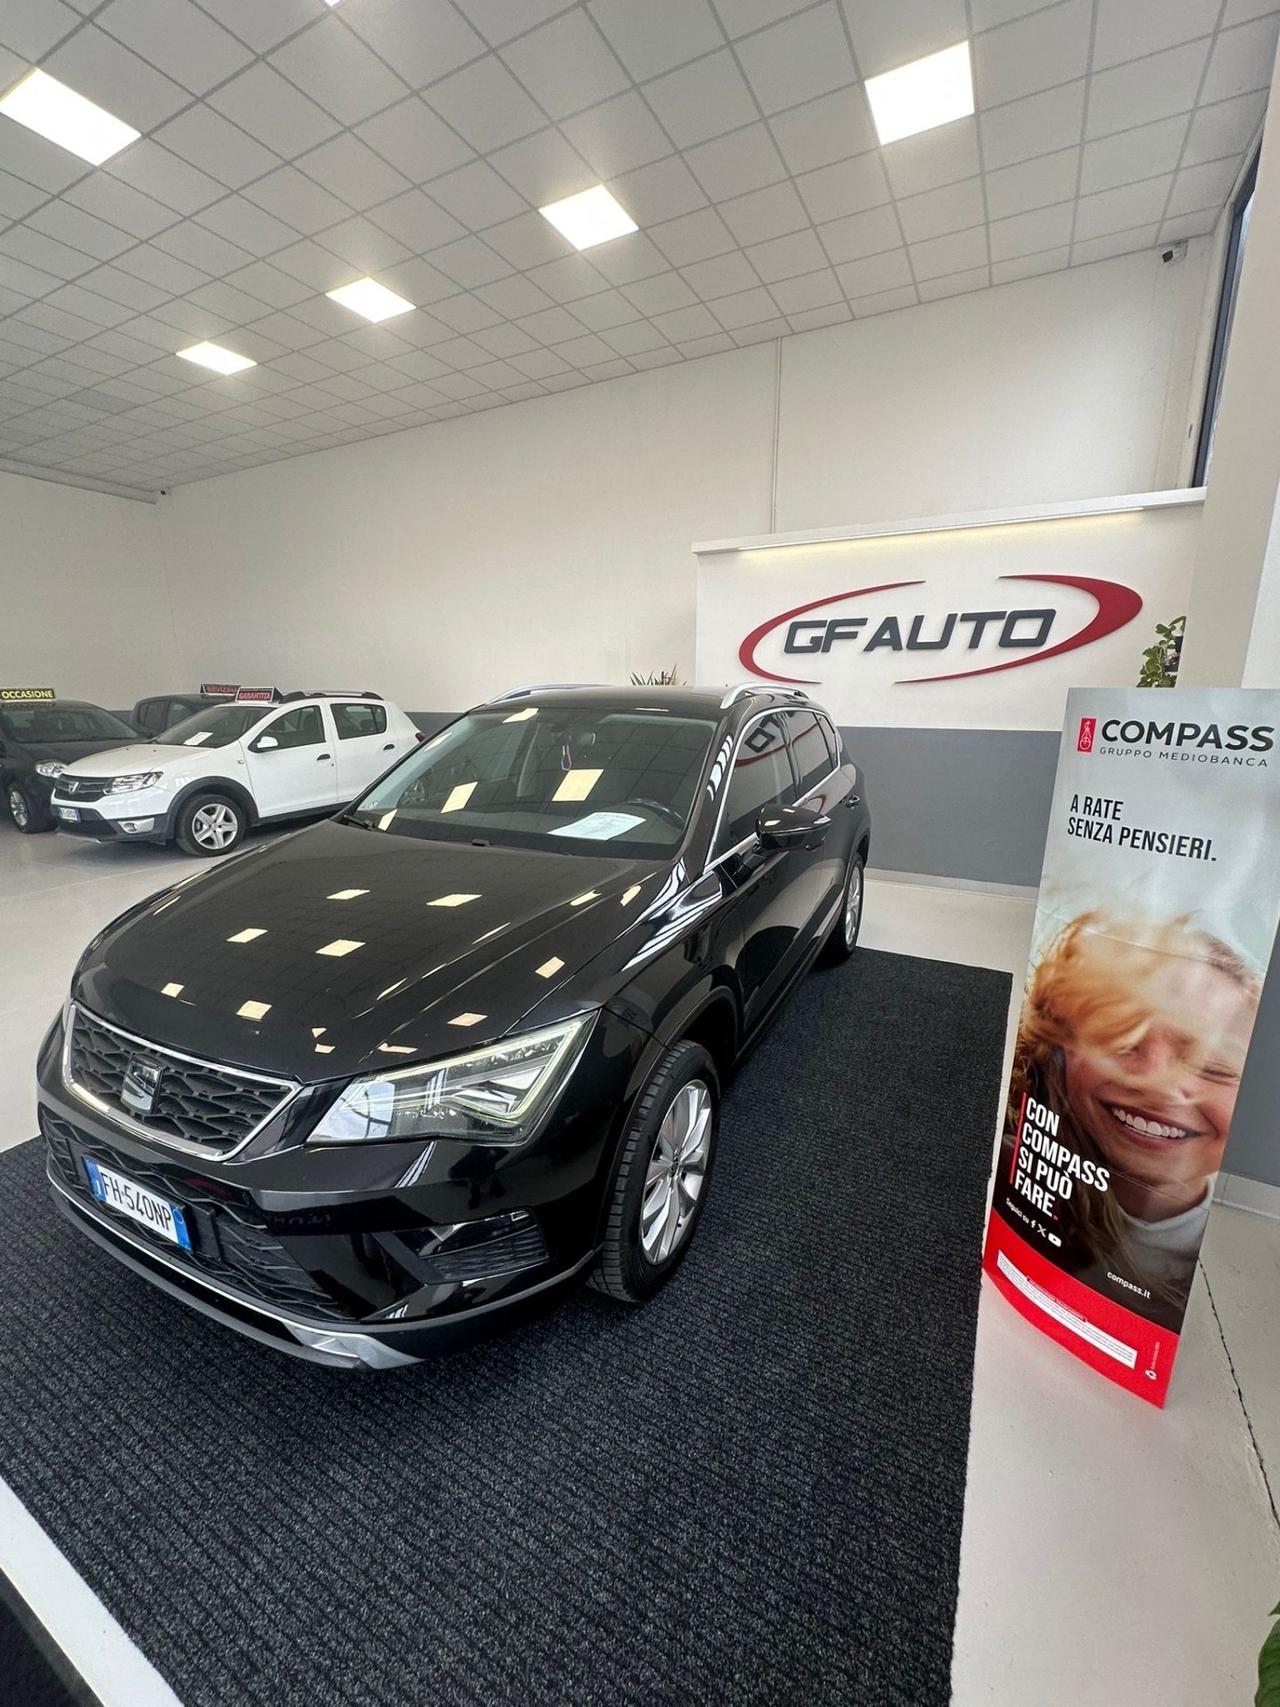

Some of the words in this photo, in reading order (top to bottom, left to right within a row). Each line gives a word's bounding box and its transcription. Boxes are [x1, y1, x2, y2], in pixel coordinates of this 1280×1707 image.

[1, 690, 53, 699] OCCASIONE
[1101, 719, 1275, 752] COMPASS
[1100, 746, 1152, 758] GRUPPO
[1158, 751, 1268, 767] MEDIOBANCA
[1070, 794, 1079, 813] A
[1083, 796, 1124, 820] RATE
[1067, 816, 1113, 844] SENZA
[1118, 826, 1217, 862] PENSIERI.
[1026, 1097, 1060, 1137] CON
[1018, 1146, 1033, 1174] SI
[1035, 1159, 1073, 1200] PUÒ
[1021, 1122, 1110, 1192] COMPASS
[1107, 1272, 1151, 1300] compass.it
